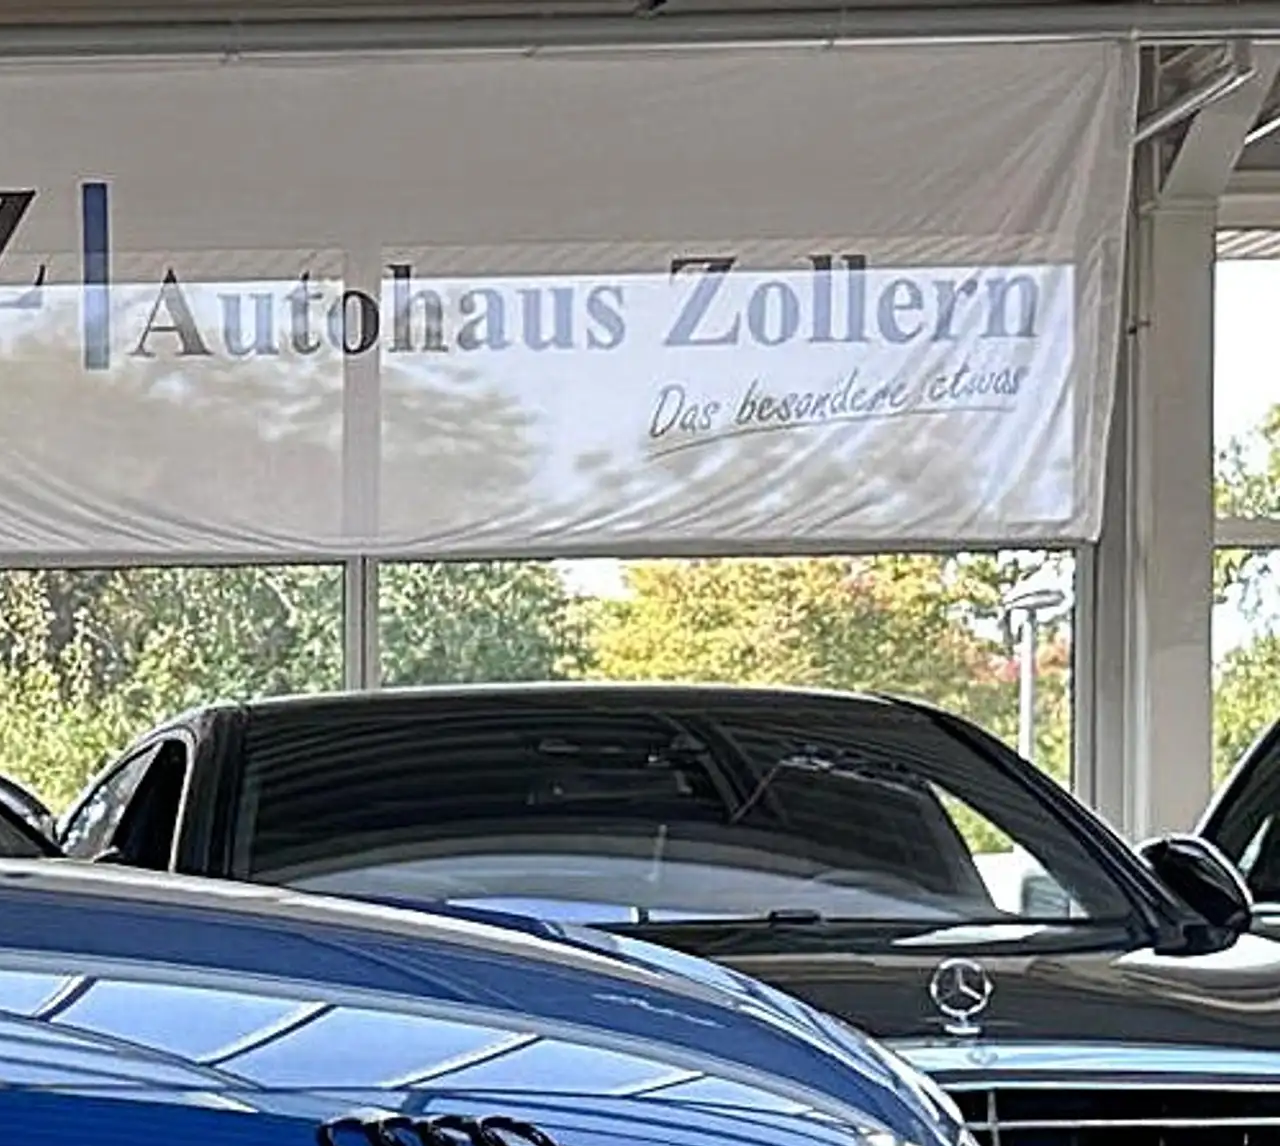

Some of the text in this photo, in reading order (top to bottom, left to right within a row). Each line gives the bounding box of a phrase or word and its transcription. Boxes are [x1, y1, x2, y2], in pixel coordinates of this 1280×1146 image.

[132, 254, 1041, 357] Autohaus Zollern
[649, 355, 1028, 438] Das besondere etwas
